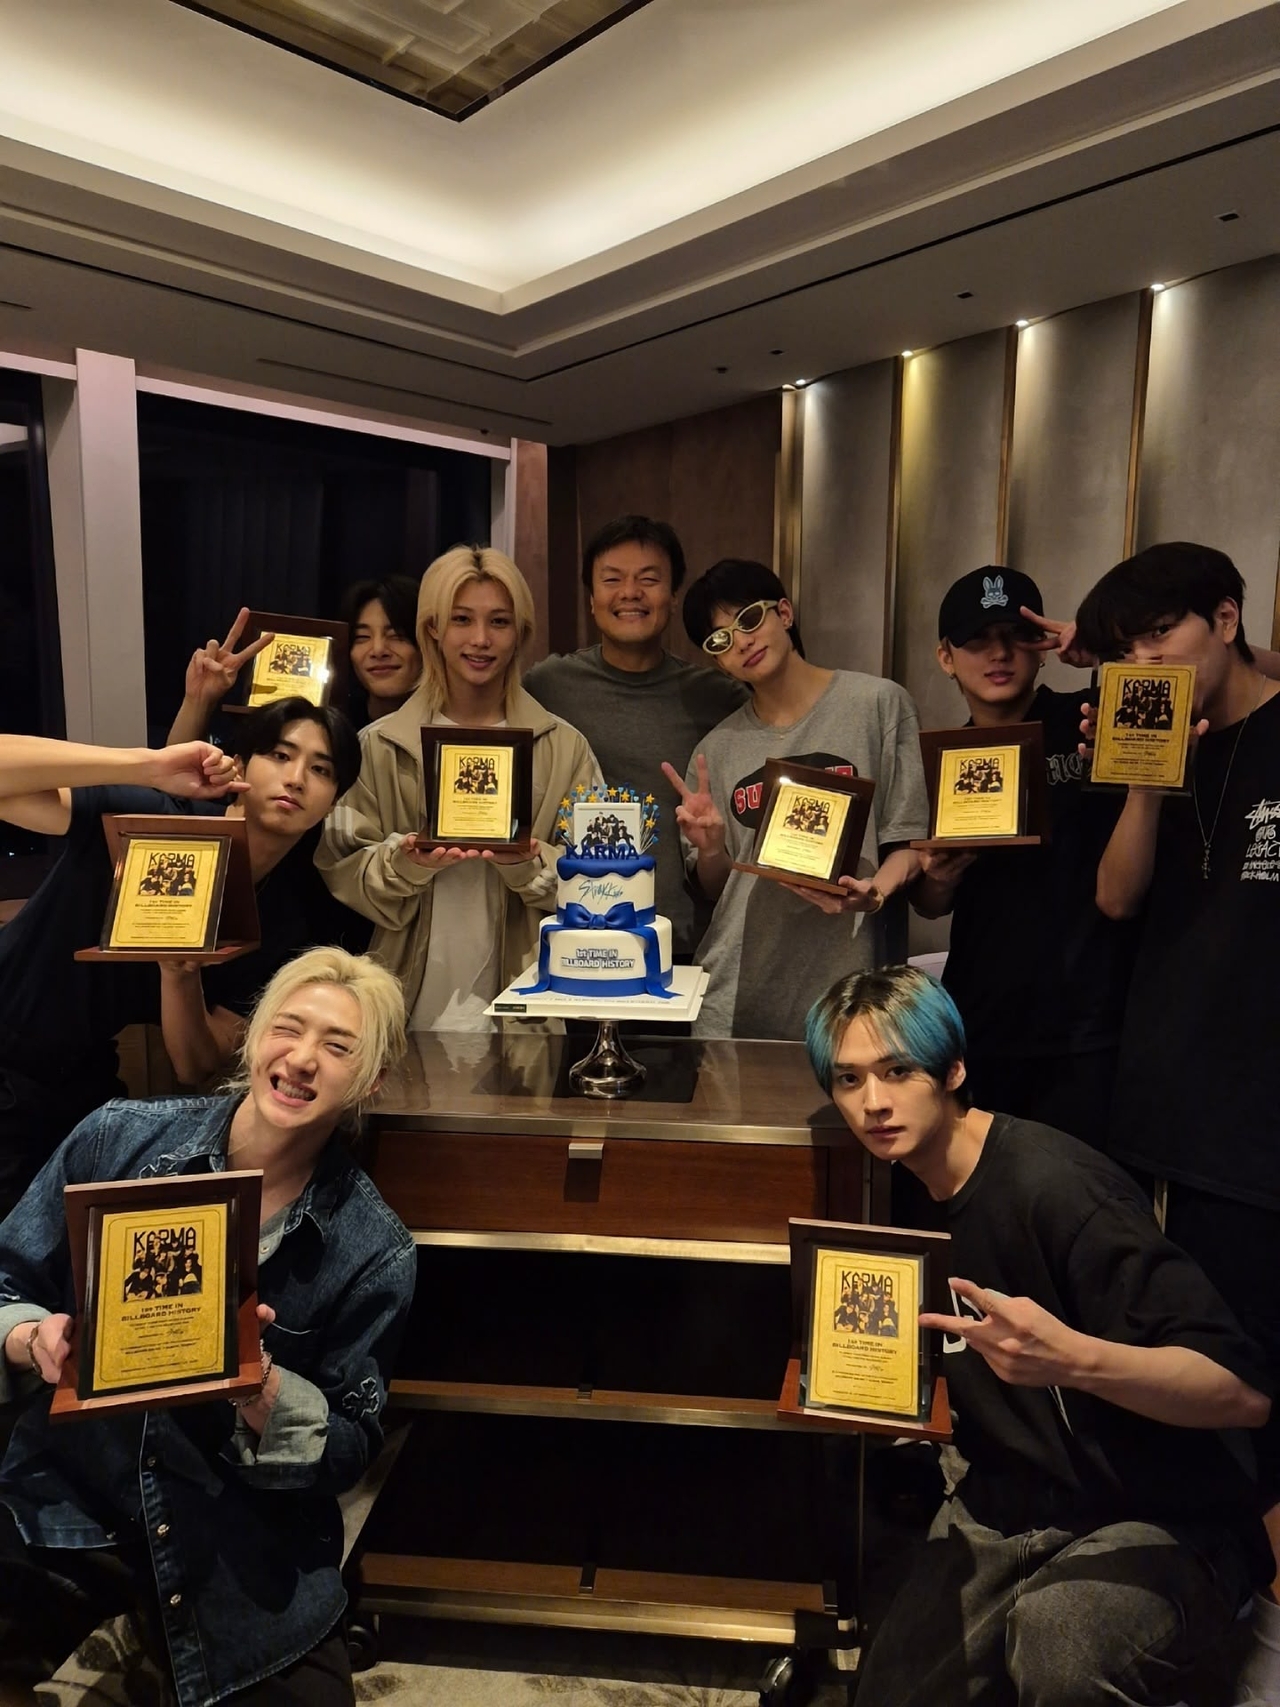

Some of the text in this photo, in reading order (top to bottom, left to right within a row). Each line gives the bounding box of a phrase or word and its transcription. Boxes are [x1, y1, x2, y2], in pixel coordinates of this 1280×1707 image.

[1123, 678, 1170, 698] KARMA
[459, 756, 495, 770] KARMA
[960, 757, 999, 771] KARMA
[793, 795, 831, 813] KARMA
[565, 843, 641, 860] KARMA
[148, 852, 195, 869] KARMA
[588, 949, 607, 958] TIME
[608, 949, 618, 958] IN
[601, 958, 635, 969] HISTORY
[133, 1226, 196, 1254] KARMA
[841, 1270, 893, 1296] KARMA
[121, 1307, 201, 1321] BILLBOARD HISTORY
